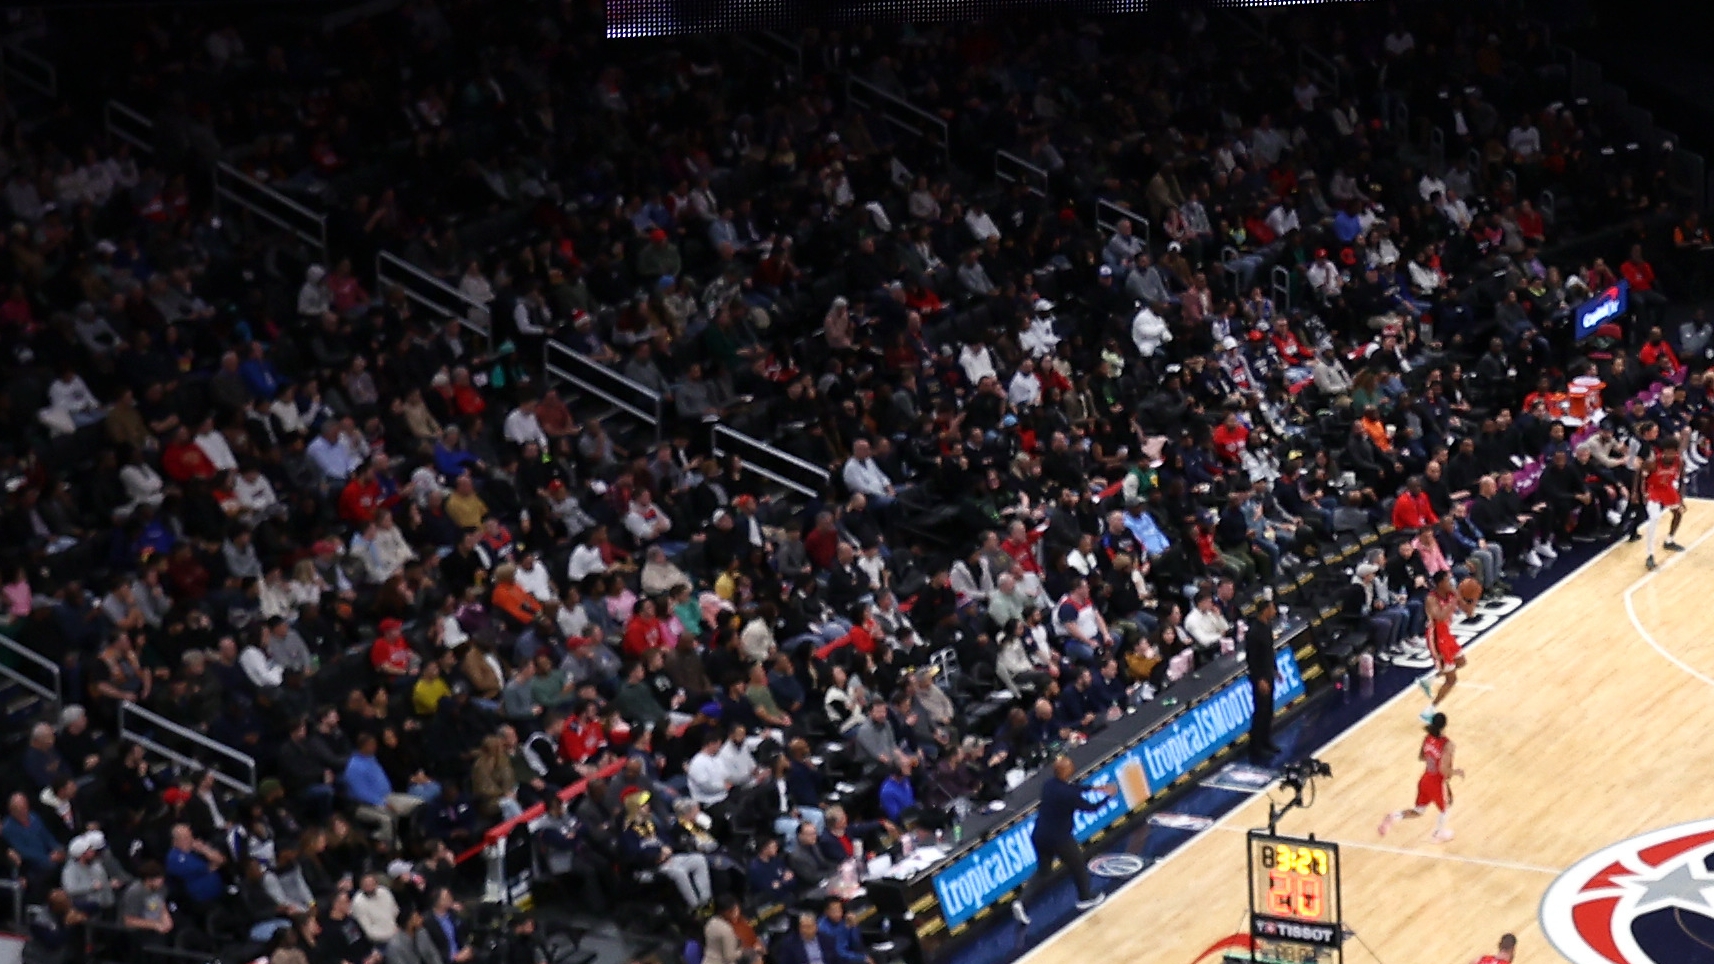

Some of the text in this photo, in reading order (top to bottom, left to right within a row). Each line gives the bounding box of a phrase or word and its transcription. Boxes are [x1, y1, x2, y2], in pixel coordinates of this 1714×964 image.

[1276, 844, 1328, 875] 3:27
[1266, 868, 1323, 918] 20
[1278, 923, 1334, 943] TISSOT
